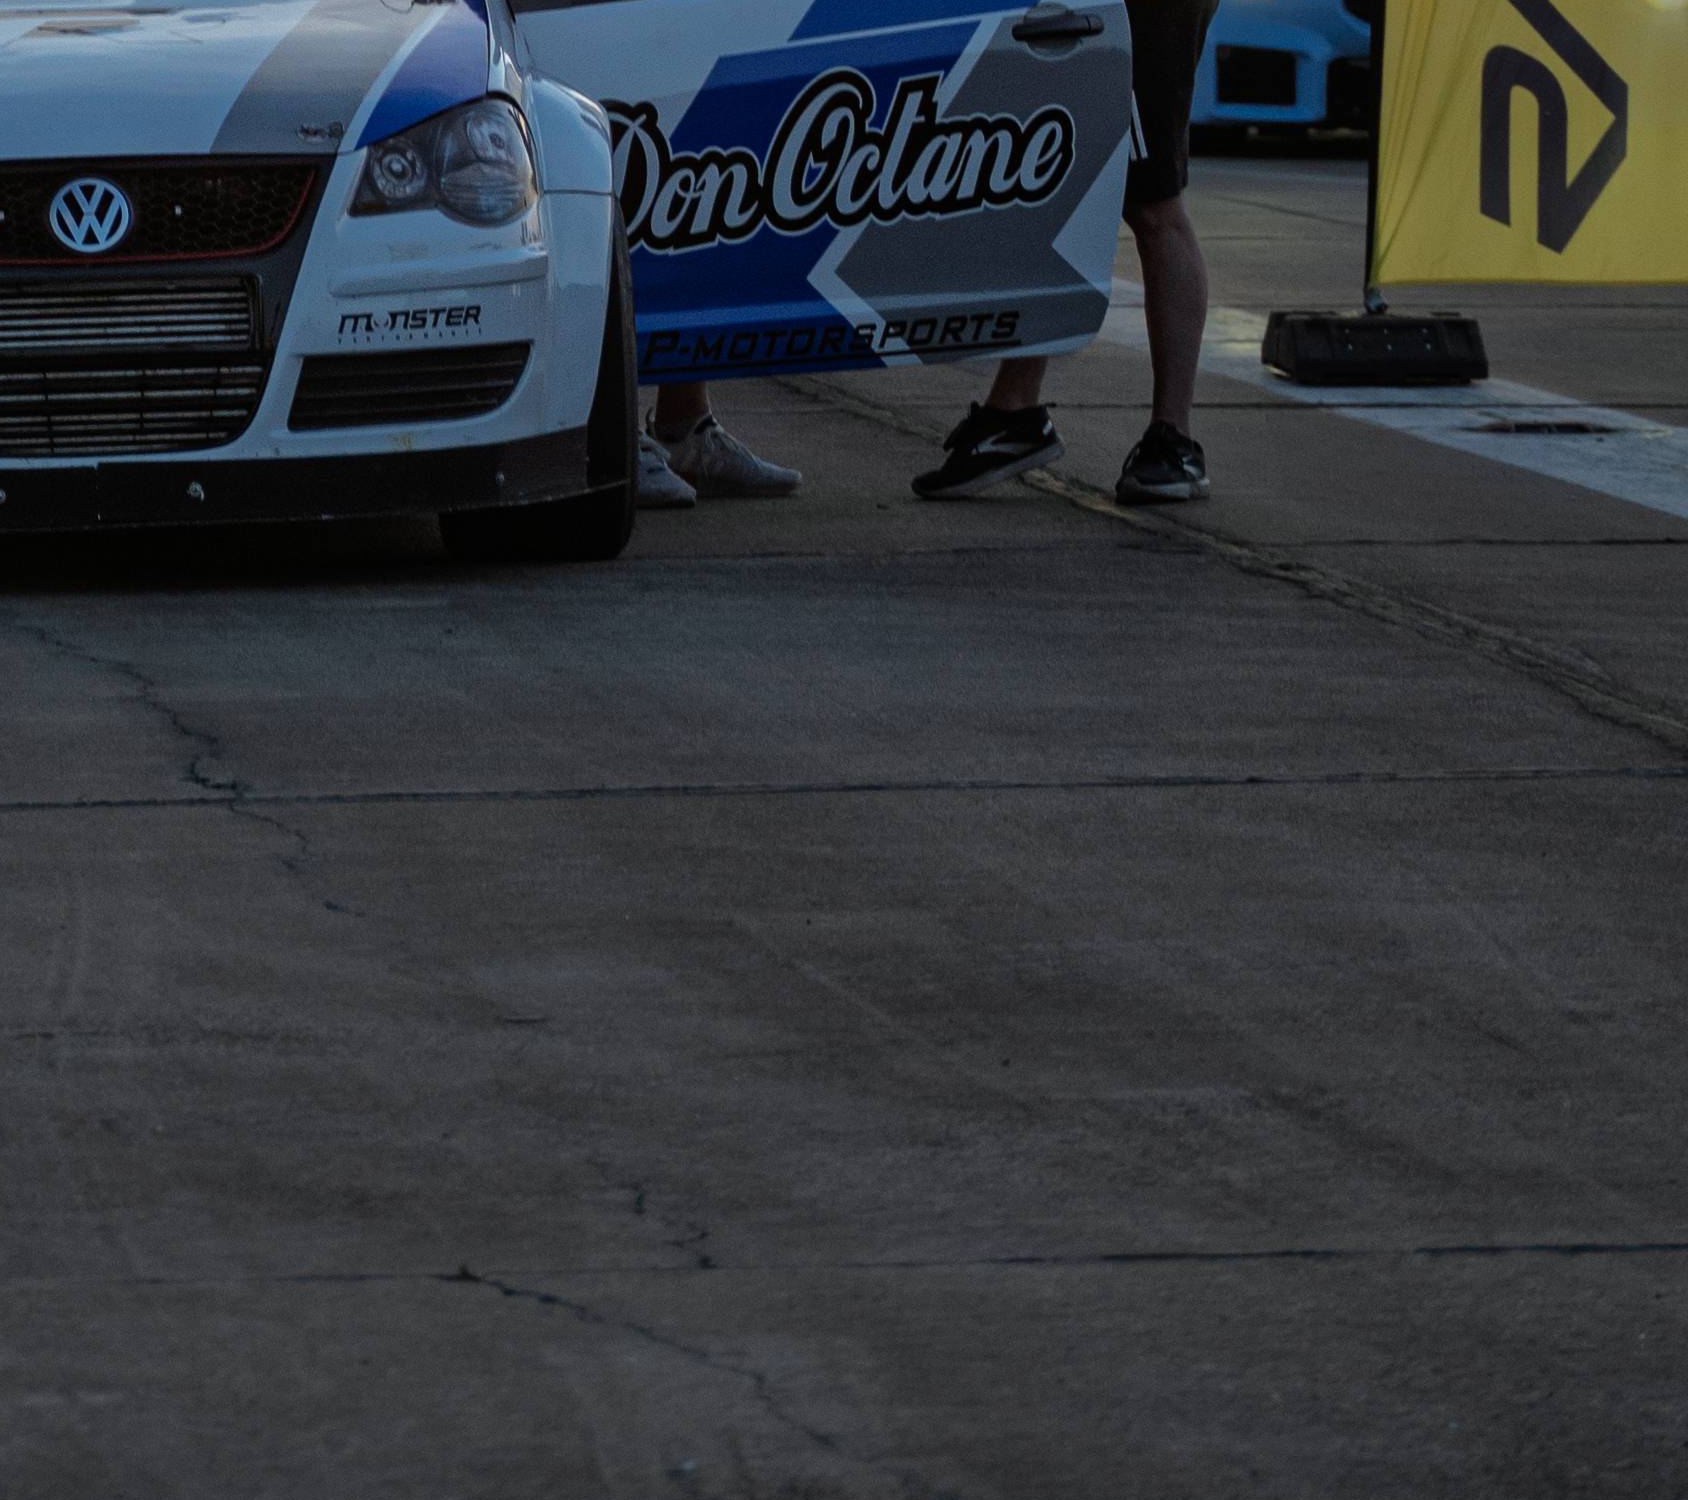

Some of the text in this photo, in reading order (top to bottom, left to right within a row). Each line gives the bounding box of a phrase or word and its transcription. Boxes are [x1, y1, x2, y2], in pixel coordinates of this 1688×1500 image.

[612, 70, 1071, 250] Don Octane
[642, 310, 1020, 366] P-MOTORSPORTS
